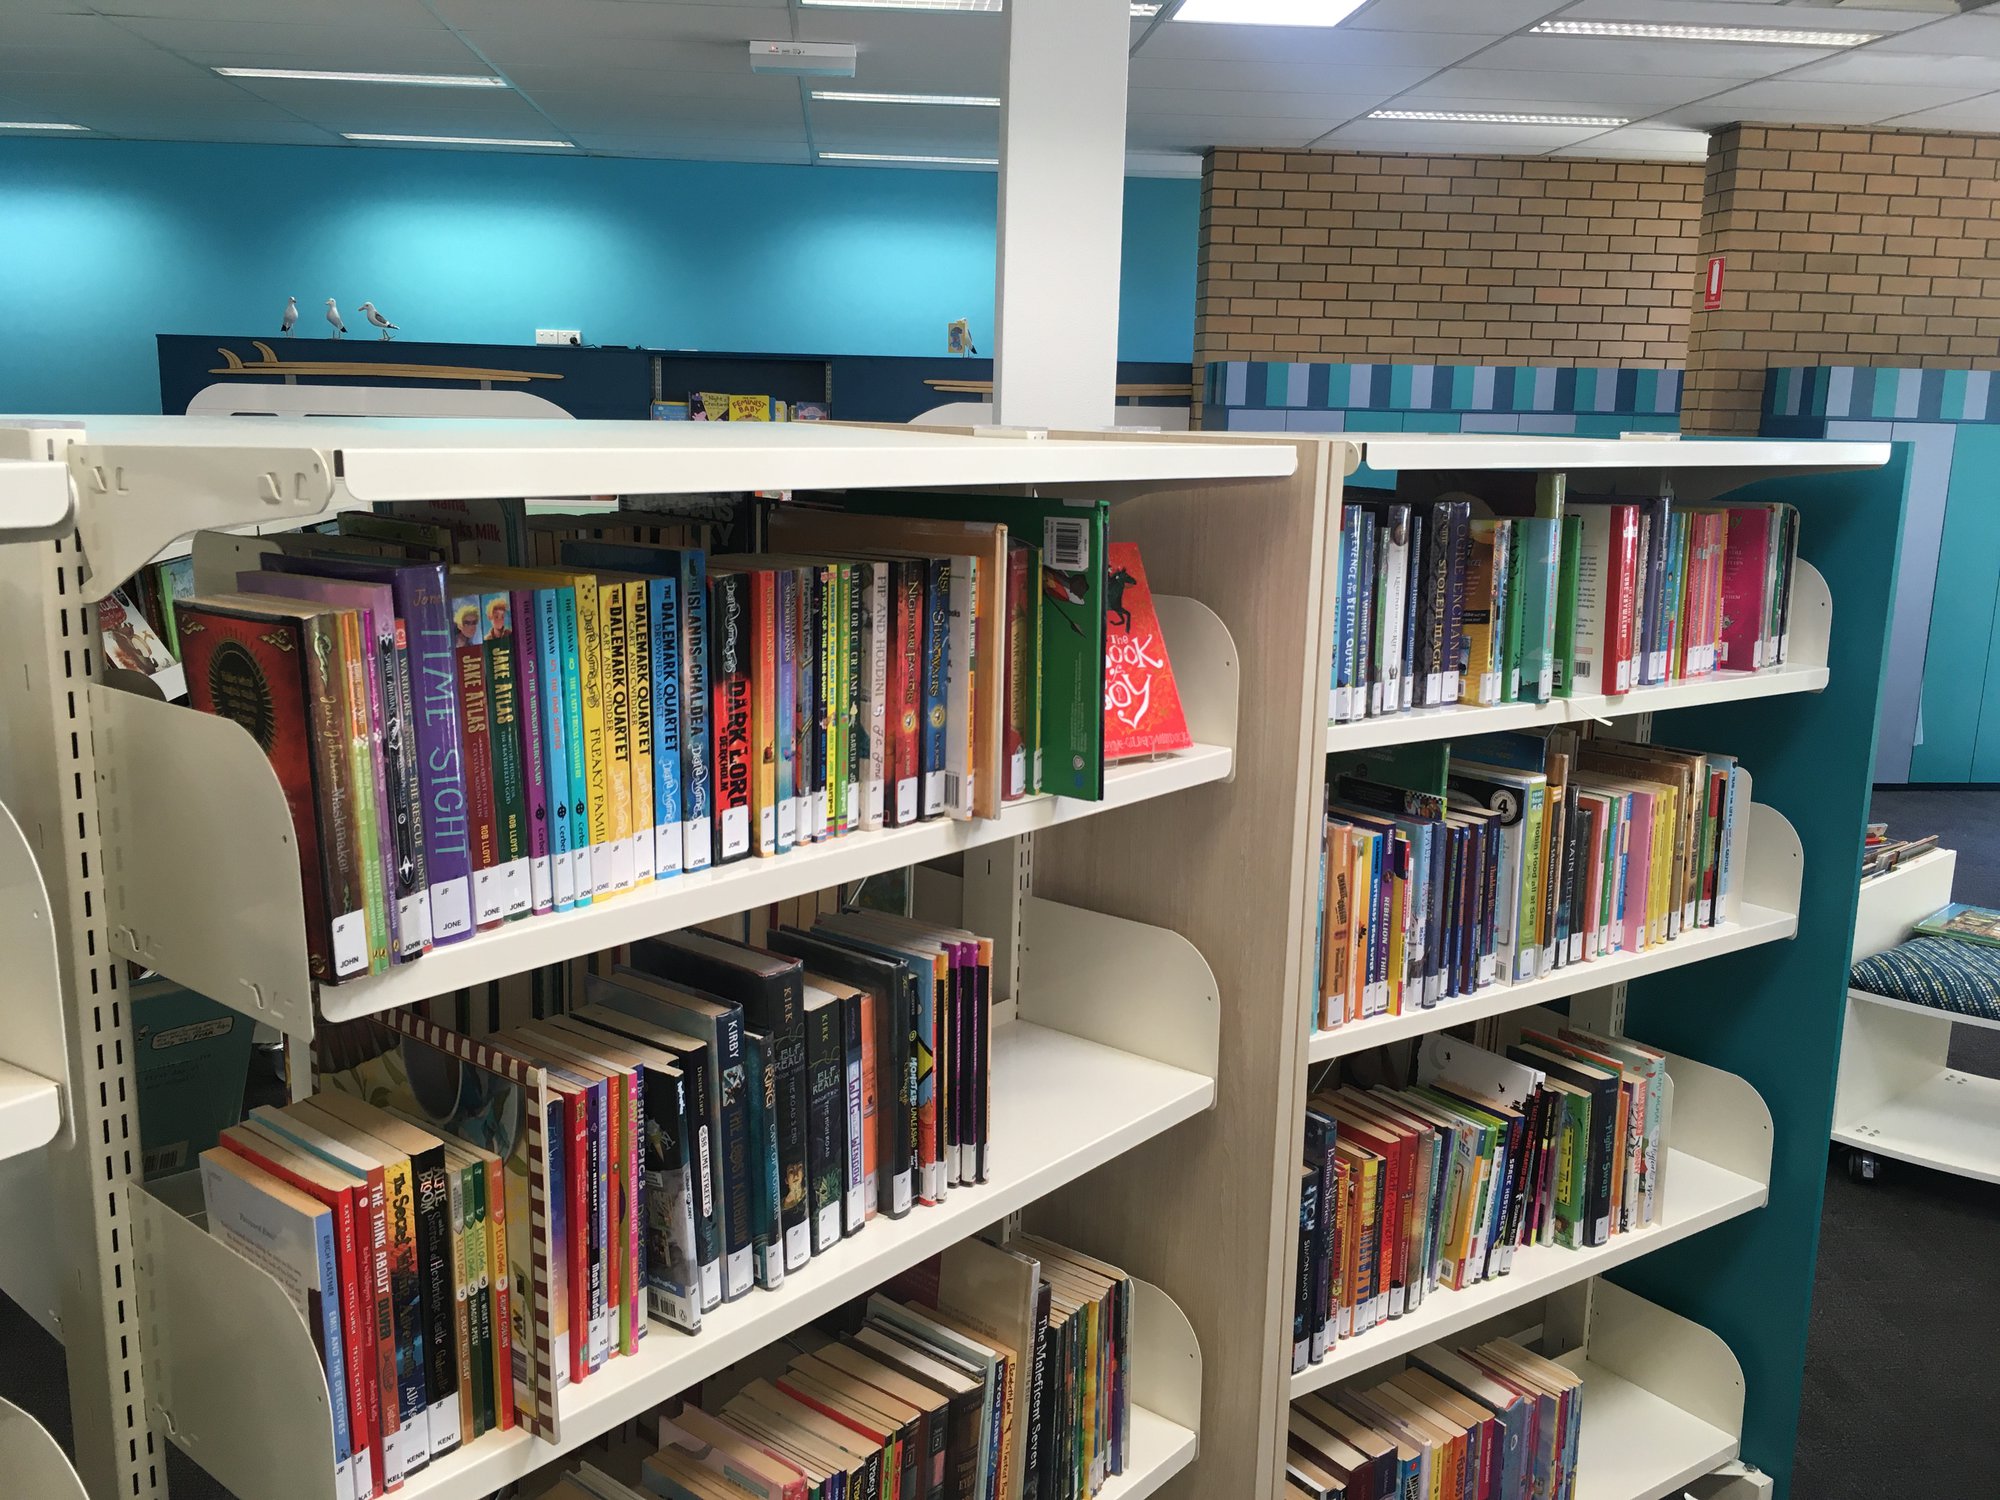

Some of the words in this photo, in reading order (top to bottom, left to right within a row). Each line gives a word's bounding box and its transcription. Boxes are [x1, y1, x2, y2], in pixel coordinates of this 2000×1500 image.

[732, 399, 768, 410] FEMINIST
[738, 405, 761, 414] BABY
[1454, 523, 1467, 575] OGRE
[611, 589, 620, 604] THE
[635, 585, 645, 600] THE
[663, 584, 673, 599] THE
[851, 571, 859, 608] DEATH
[877, 576, 887, 597] PIP
[1435, 558, 1447, 620] STOLEN
[687, 591, 702, 656] ISLANDS
[851, 612, 859, 628] OR
[876, 604, 887, 632] AND
[1359, 599, 1369, 641] WRINKLE
[525, 614, 533, 657] GATEWAY
[546, 615, 556, 656] GATEWAY
[567, 614, 576, 654] GATEWAY
[602, 624, 611, 651] CART
[609, 607, 627, 689] DALEMARK
[634, 603, 649, 685] DALEMARK
[661, 602, 677, 682] DALEMARK
[492, 647, 511, 680] JAKE
[654, 623, 664, 678] DROWNED
[421, 619, 455, 727] TIME
[462, 655, 482, 688] JAKE
[528, 660, 535, 674] 3
[603, 658, 612, 680] AND
[874, 640, 886, 697] HOUDINI
[1357, 658, 1366, 680] TIME
[400, 657, 413, 717] WARRIORS
[655, 681, 665, 718] AMMET
[688, 663, 704, 737] CHALDEA
[465, 690, 486, 734] ATLAS
[494, 683, 514, 725] ATLAS
[604, 680, 614, 732] CWIDDER
[663, 683, 678, 752] QUARTET
[727, 681, 749, 745] DARK
[613, 690, 629, 763] QUARTET
[636, 686, 651, 755] QUARTET
[590, 728, 604, 789] FREAKY
[719, 733, 729, 792] DERKHOLM
[409, 774, 419, 799] THE
[428, 746, 467, 859] SIGHT
[1498, 798, 1509, 816] 4
[412, 801, 424, 847] RESCUE
[480, 823, 489, 839] ROB
[508, 813, 517, 829] ROB
[1535, 822, 1543, 850] Robin
[482, 840, 491, 865] LLOYD
[510, 829, 519, 854] LLOYD
[1568, 838, 1578, 873] RAIN
[662, 863, 677, 872] JONE
[1532, 852, 1541, 878] Hood
[614, 879, 629, 890] JONE
[483, 906, 501, 918] JONE
[509, 901, 526, 911] JONE
[1383, 896, 1391, 944] REBELLION
[1528, 908, 1536, 926] Sea
[443, 919, 462, 931] JONE
[339, 956, 360, 969] JOHN
[783, 986, 793, 1024] KIRK
[727, 1019, 740, 1059] KIRBY
[636, 1098, 647, 1177] SHEEP-PIG
[701, 1136, 709, 1148] 88
[638, 1180, 646, 1191] &
[1507, 1157, 1516, 1186] SPACE
[371, 1182, 385, 1209] THE
[417, 1168, 432, 1216] BLOOM
[702, 1171, 711, 1208] STREET
[1322, 1187, 1332, 1225] Stories
[373, 1212, 387, 1250] THING
[393, 1195, 413, 1249] Secret
[427, 1209, 441, 1252] Secrets
[323, 1234, 333, 1262] ERICH
[1303, 1239, 1311, 1269] SIMON
[375, 1252, 390, 1295] ABOUT
[430, 1256, 446, 1314] Hexbridge
[591, 1263, 600, 1290] Mosh
[1301, 1271, 1311, 1301] MAYO
[328, 1310, 338, 1335] EMIL
[469, 1299, 477, 1324] DRAGON
[480, 1301, 488, 1322] WORST
[432, 1312, 447, 1345] Castle
[482, 1325, 490, 1339] PET
[1036, 1314, 1049, 1344] The
[330, 1336, 340, 1355] AND
[332, 1358, 341, 1374] THE
[997, 1364, 1004, 1382] DO
[405, 1386, 417, 1408] Ally
[995, 1385, 1003, 1408] YOU
[1031, 1345, 1049, 1421] Maleficent
[334, 1376, 346, 1436] DETECTIVES
[385, 1443, 395, 1452] JF
[437, 1433, 455, 1447] KENT
[1028, 1422, 1042, 1471] Seven
[336, 1466, 345, 1476] JF
[406, 1450, 426, 1465] KENN
[387, 1471, 404, 1485] KELL
[867, 1456, 881, 1493] Tracy
